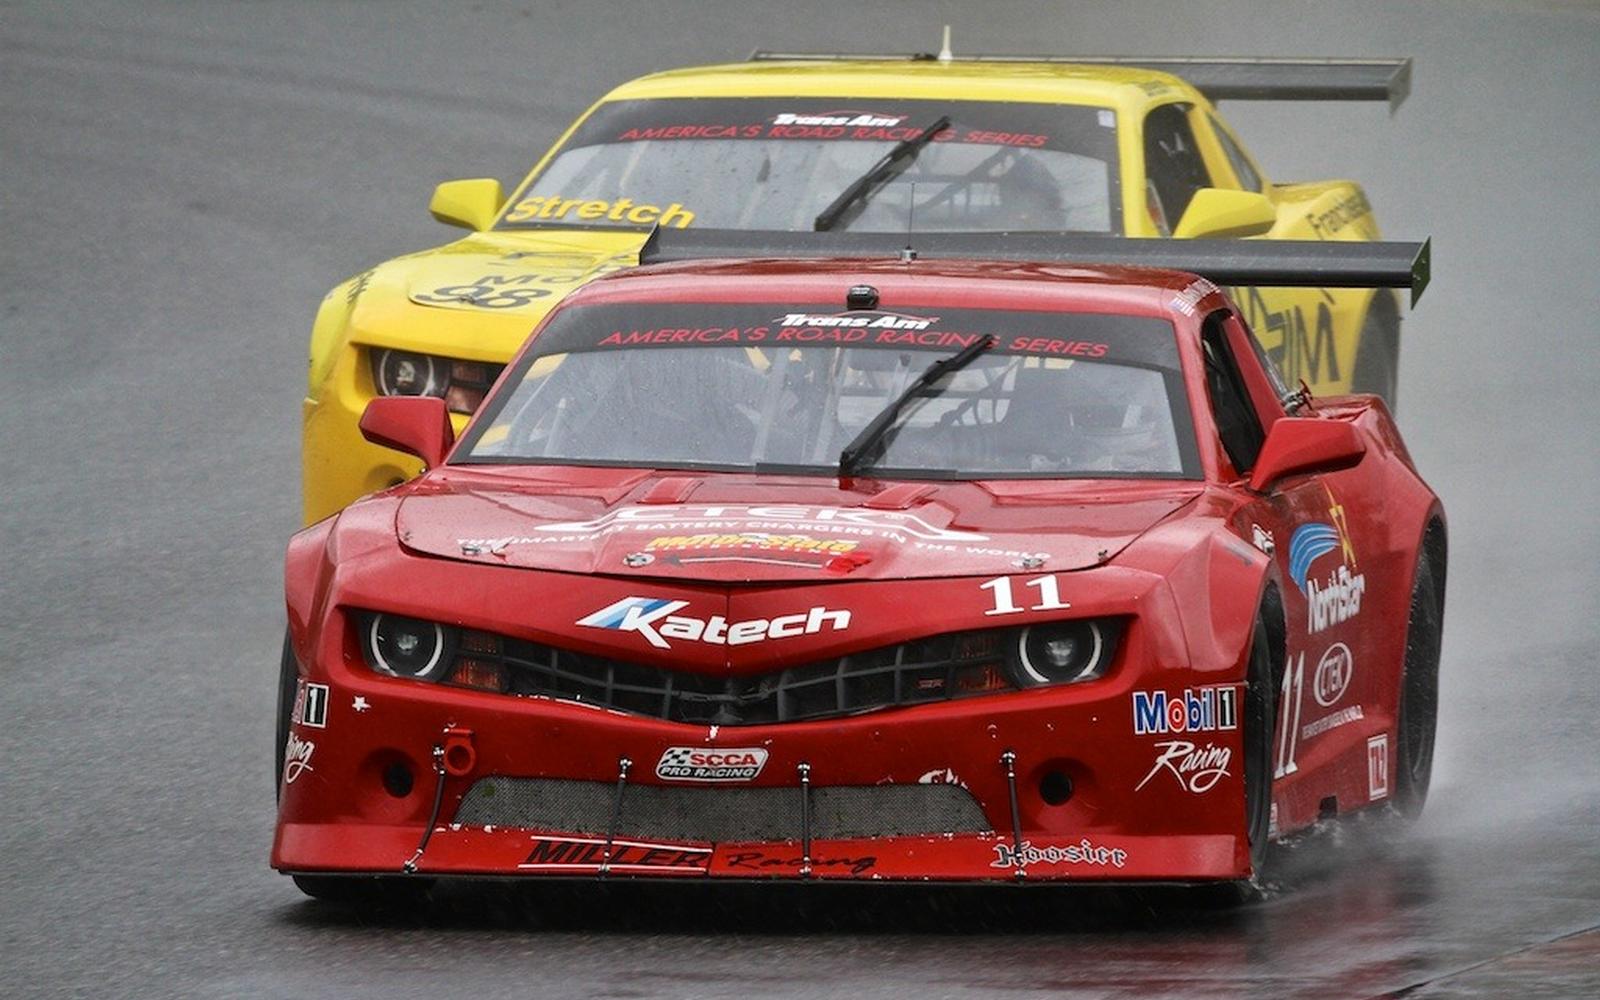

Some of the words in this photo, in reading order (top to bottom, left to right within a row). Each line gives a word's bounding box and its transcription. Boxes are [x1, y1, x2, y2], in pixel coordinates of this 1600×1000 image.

[619, 124, 763, 141] AMERICA'S
[768, 124, 845, 139] ROAD
[963, 130, 1048, 148] SERIES
[505, 195, 696, 229] Stretch
[599, 327, 770, 346] AMERICA'S
[776, 328, 868, 342] ROAD
[1008, 336, 1109, 358] SERIES
[634, 521, 740, 532] BATTERY
[745, 521, 875, 536] CHARGERS
[881, 531, 907, 544] IN
[914, 542, 958, 552] THE
[965, 546, 1052, 560] WORLD
[980, 574, 1071, 616] 11
[575, 596, 852, 650] Katech
[1132, 687, 1215, 735] Mobil
[1273, 650, 1304, 779] 11
[660, 766, 692, 777] PRO
[693, 767, 756, 778] RACING
[689, 753, 758, 767] SCCA
[1134, 740, 1232, 793] Racing
[526, 838, 711, 868] MILLER
[989, 838, 1128, 868] Hoosier
